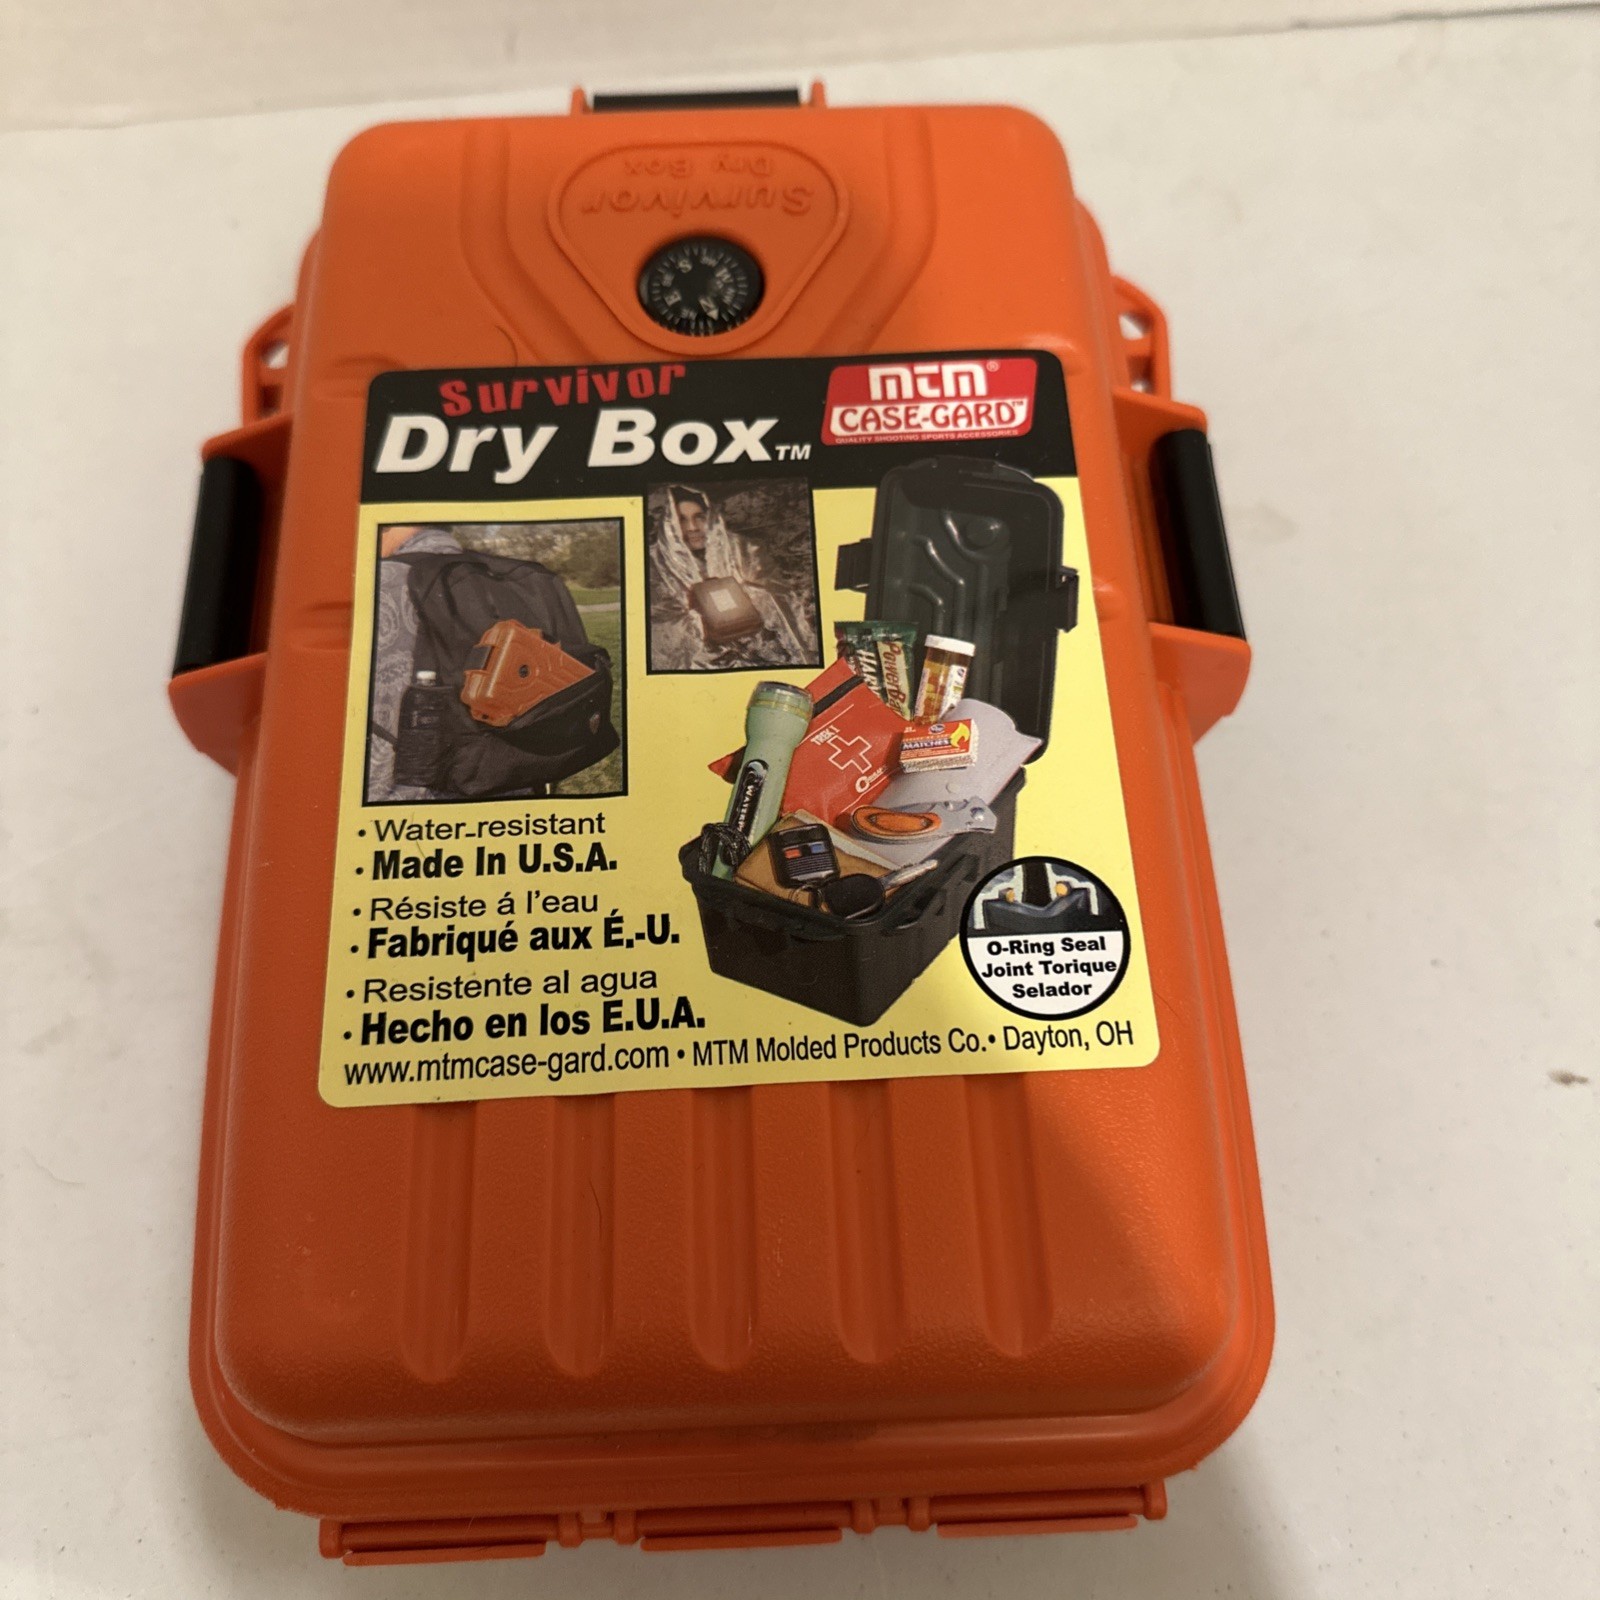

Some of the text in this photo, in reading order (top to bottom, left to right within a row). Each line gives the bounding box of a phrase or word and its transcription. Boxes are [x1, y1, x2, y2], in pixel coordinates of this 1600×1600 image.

[581, 185, 815, 219] Survivor
[439, 363, 687, 417] Survivor
[374, 413, 558, 485] Dry
[587, 408, 779, 468] Box
[835, 429, 1019, 445] QUALITY SHOOTING SPORTS ACCESSORIES
[372, 842, 617, 880] Made In U.S.A.
[370, 895, 487, 922] Résiste
[497, 892, 516, 915] á
[368, 908, 680, 962] Fabriqué aux É.-U.
[986, 936, 1107, 957] O-Ring Seal
[981, 959, 1117, 978] Joint Torique
[364, 970, 658, 1003] Resistente al agua
[1012, 982, 1093, 999] Selador
[361, 996, 706, 1046] Hecho en los E.U.A.
[344, 1020, 1134, 1086] www.mtmcase-gard.com MTM Molded Products Co. Dayton, OH
